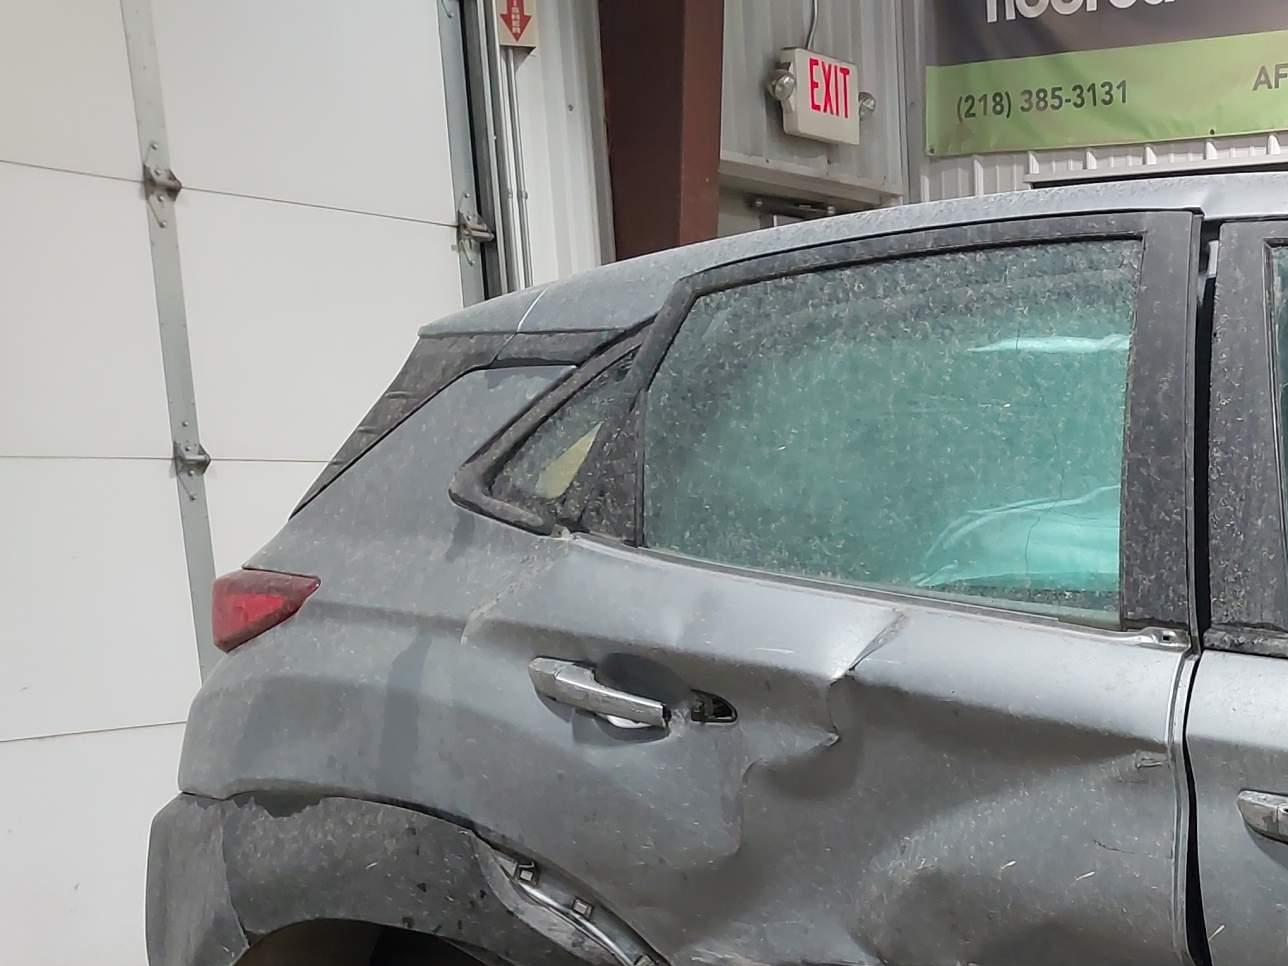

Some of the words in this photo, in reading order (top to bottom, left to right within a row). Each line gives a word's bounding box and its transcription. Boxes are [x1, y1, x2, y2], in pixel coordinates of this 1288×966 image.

[809, 58, 850, 118] EXIT
[956, 89, 1012, 122] (218)
[1020, 79, 1128, 113] 385-3131
